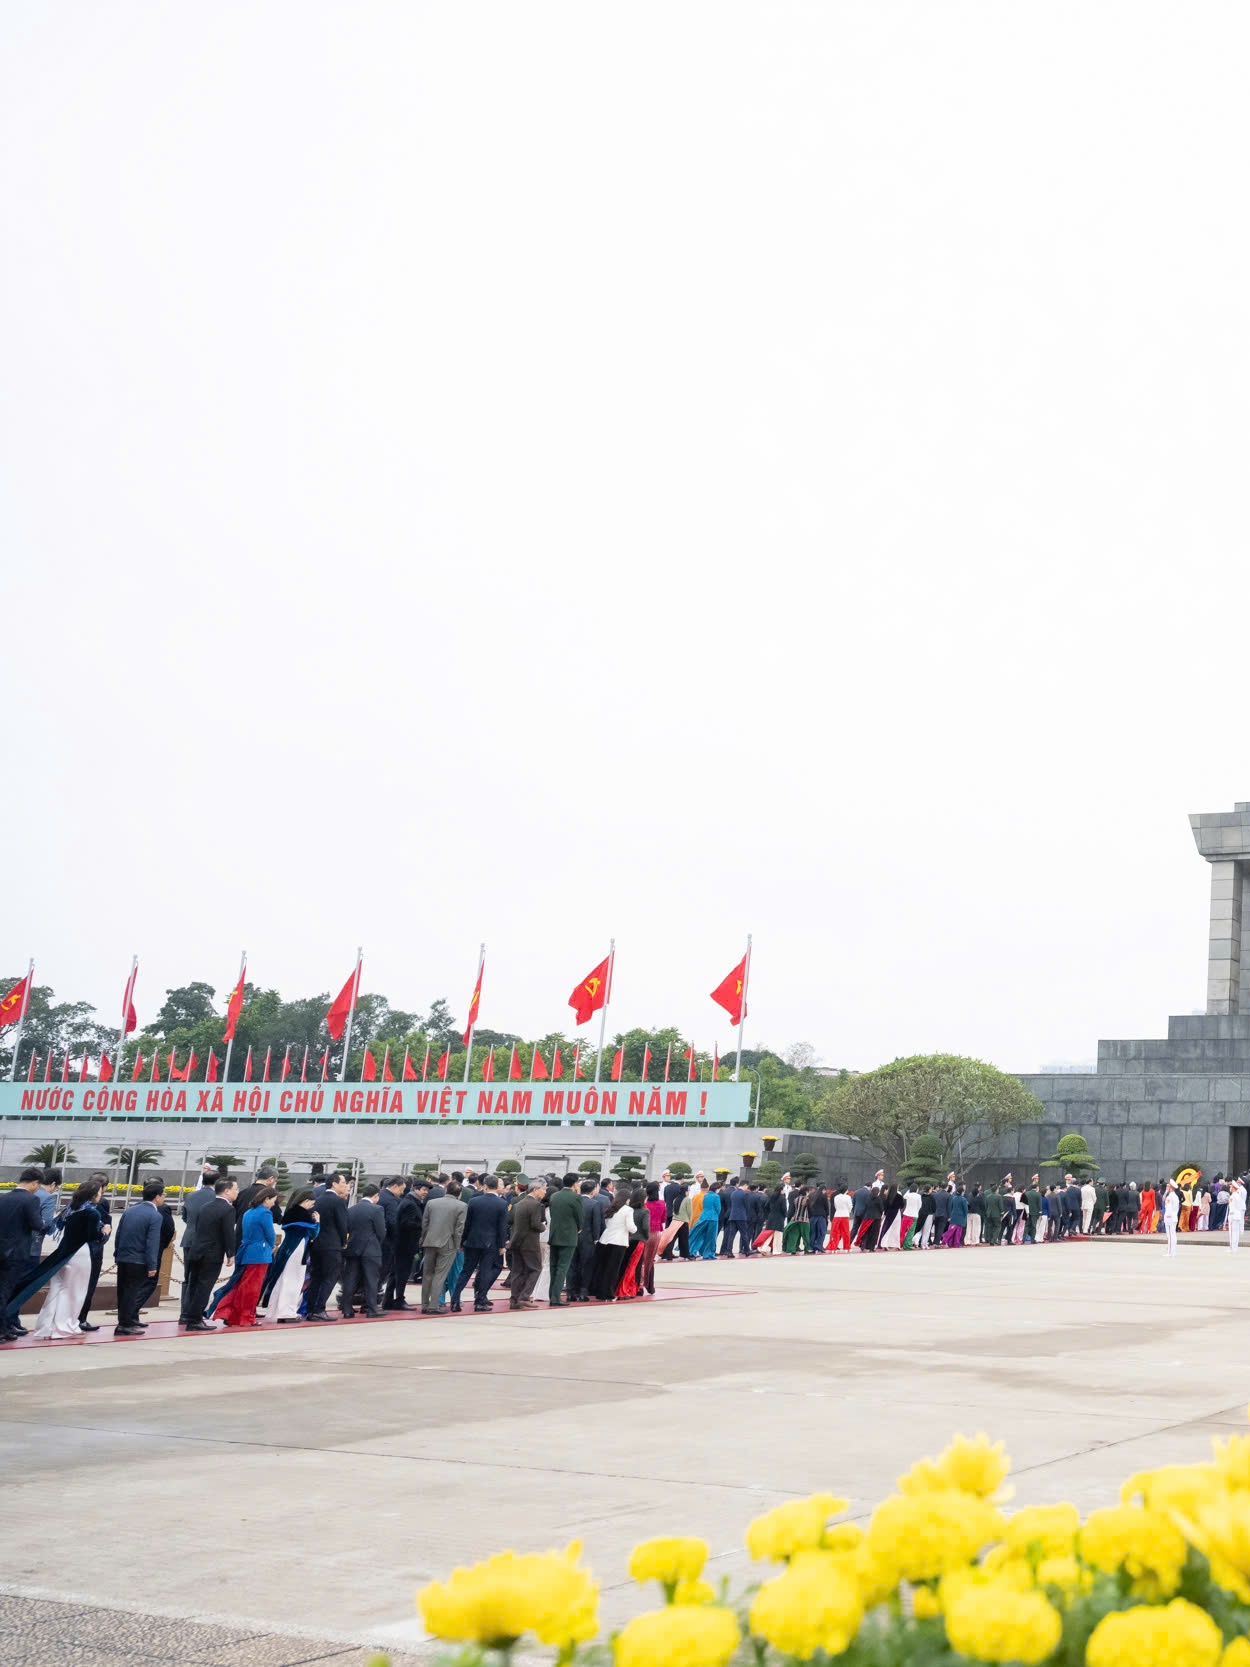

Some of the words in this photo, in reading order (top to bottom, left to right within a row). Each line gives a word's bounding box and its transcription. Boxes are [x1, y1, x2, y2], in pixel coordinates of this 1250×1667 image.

[21, 1087, 74, 1111] NƯỚC
[83, 1086, 138, 1115] CỘNG
[146, 1087, 187, 1112] HÒA
[196, 1087, 223, 1112] XÃ
[233, 1085, 270, 1117] HỘI
[280, 1084, 324, 1113] CHỦ
[333, 1087, 403, 1114] NGHĨA
[417, 1086, 467, 1118] VIỆT
[477, 1090, 533, 1115] NAM
[542, 1086, 618, 1115] MUÔN
[628, 1087, 688, 1116] NĂM
